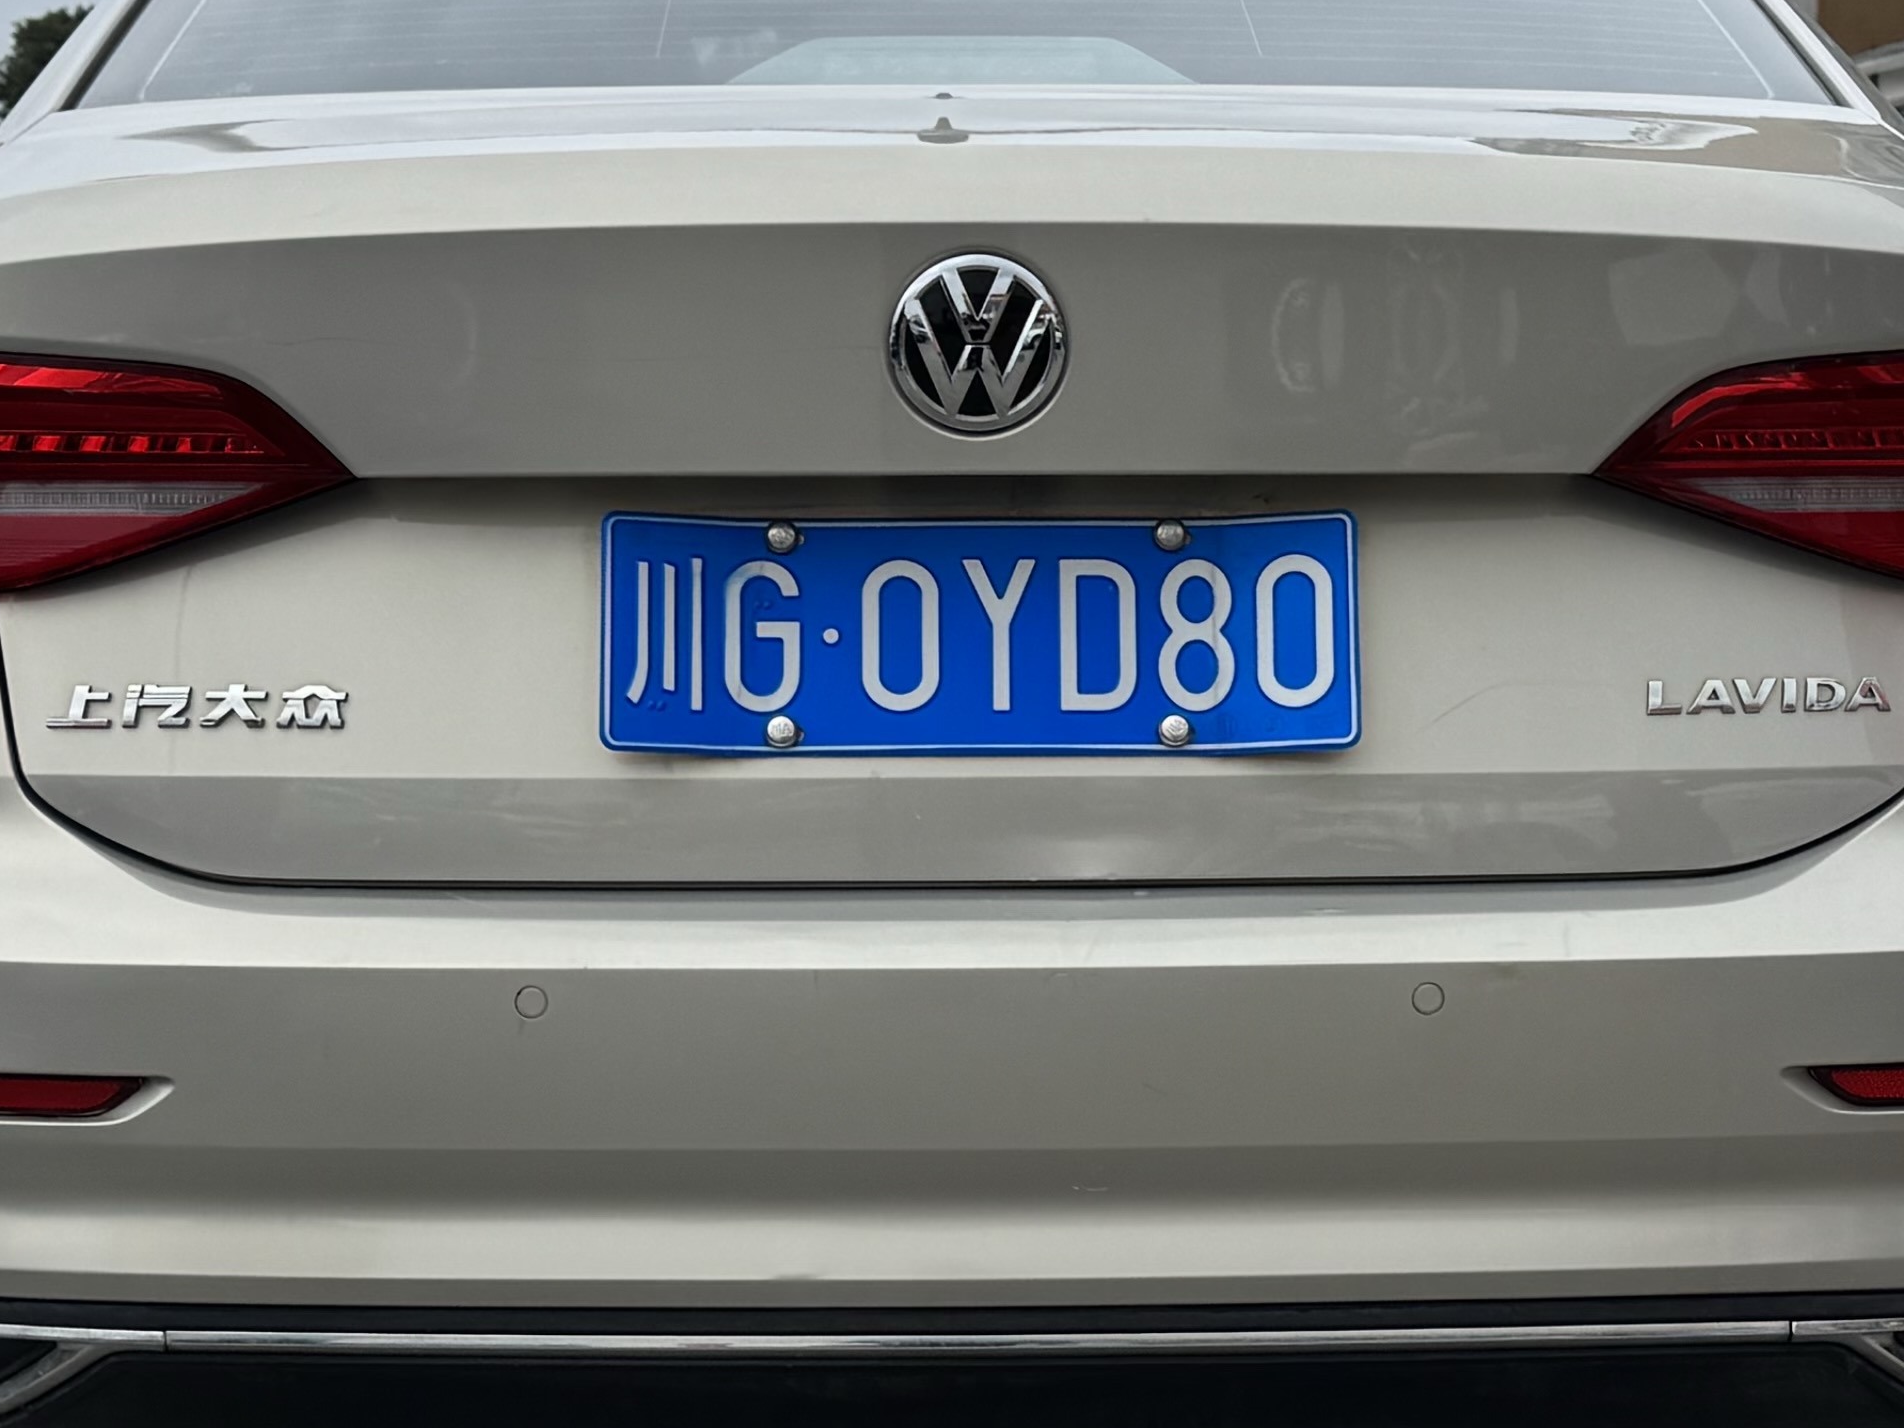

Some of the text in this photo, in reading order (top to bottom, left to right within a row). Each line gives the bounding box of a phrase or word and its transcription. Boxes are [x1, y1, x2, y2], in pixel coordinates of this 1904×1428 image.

[45, 683, 349, 729] 上汽大众
[1646, 675, 1893, 716] LAVIDA
